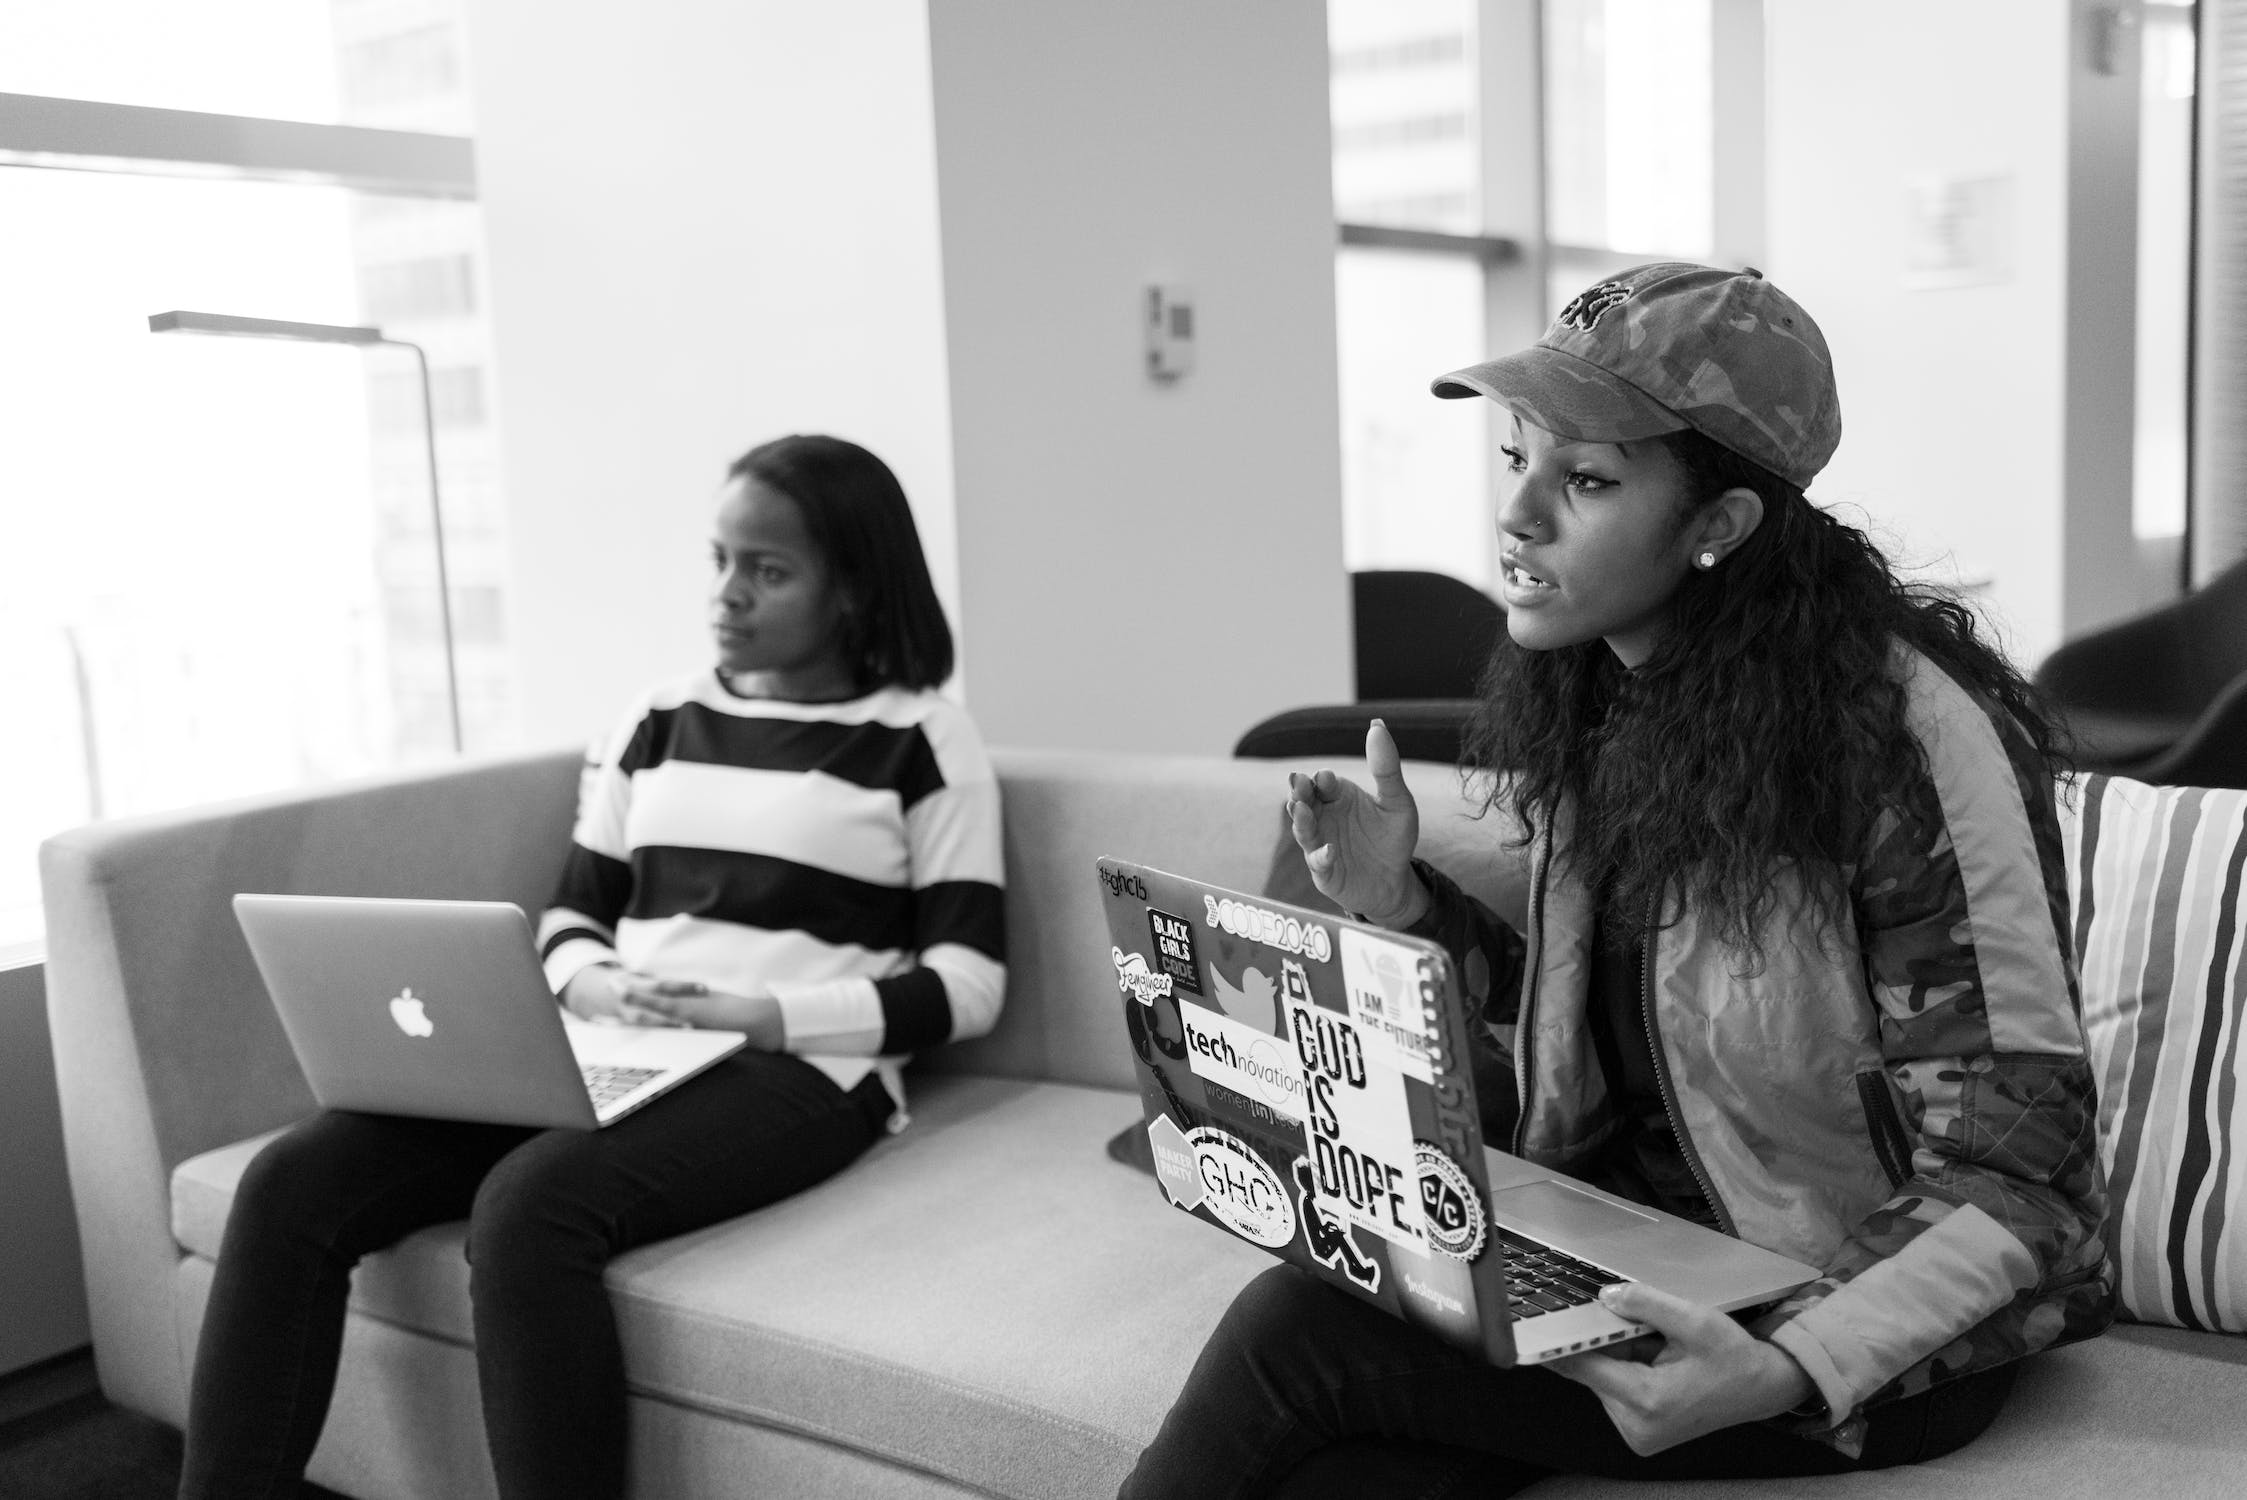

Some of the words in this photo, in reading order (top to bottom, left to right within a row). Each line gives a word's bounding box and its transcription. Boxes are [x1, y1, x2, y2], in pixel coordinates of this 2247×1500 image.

[1152, 914, 1190, 944] BLACK
[1160, 935, 1191, 961] GIRLS
[1161, 956, 1196, 981] CODE
[1364, 992, 1384, 1015] AM
[1186, 1023, 1304, 1097] technovation
[1293, 1007, 1367, 1090] GOD
[1303, 1069, 1340, 1141] IS
[1157, 1145, 1194, 1170] MAKER
[1160, 1159, 1193, 1184] PARTY
[1199, 1153, 1271, 1208] GHC
[1314, 1133, 1423, 1239] DOPE.
